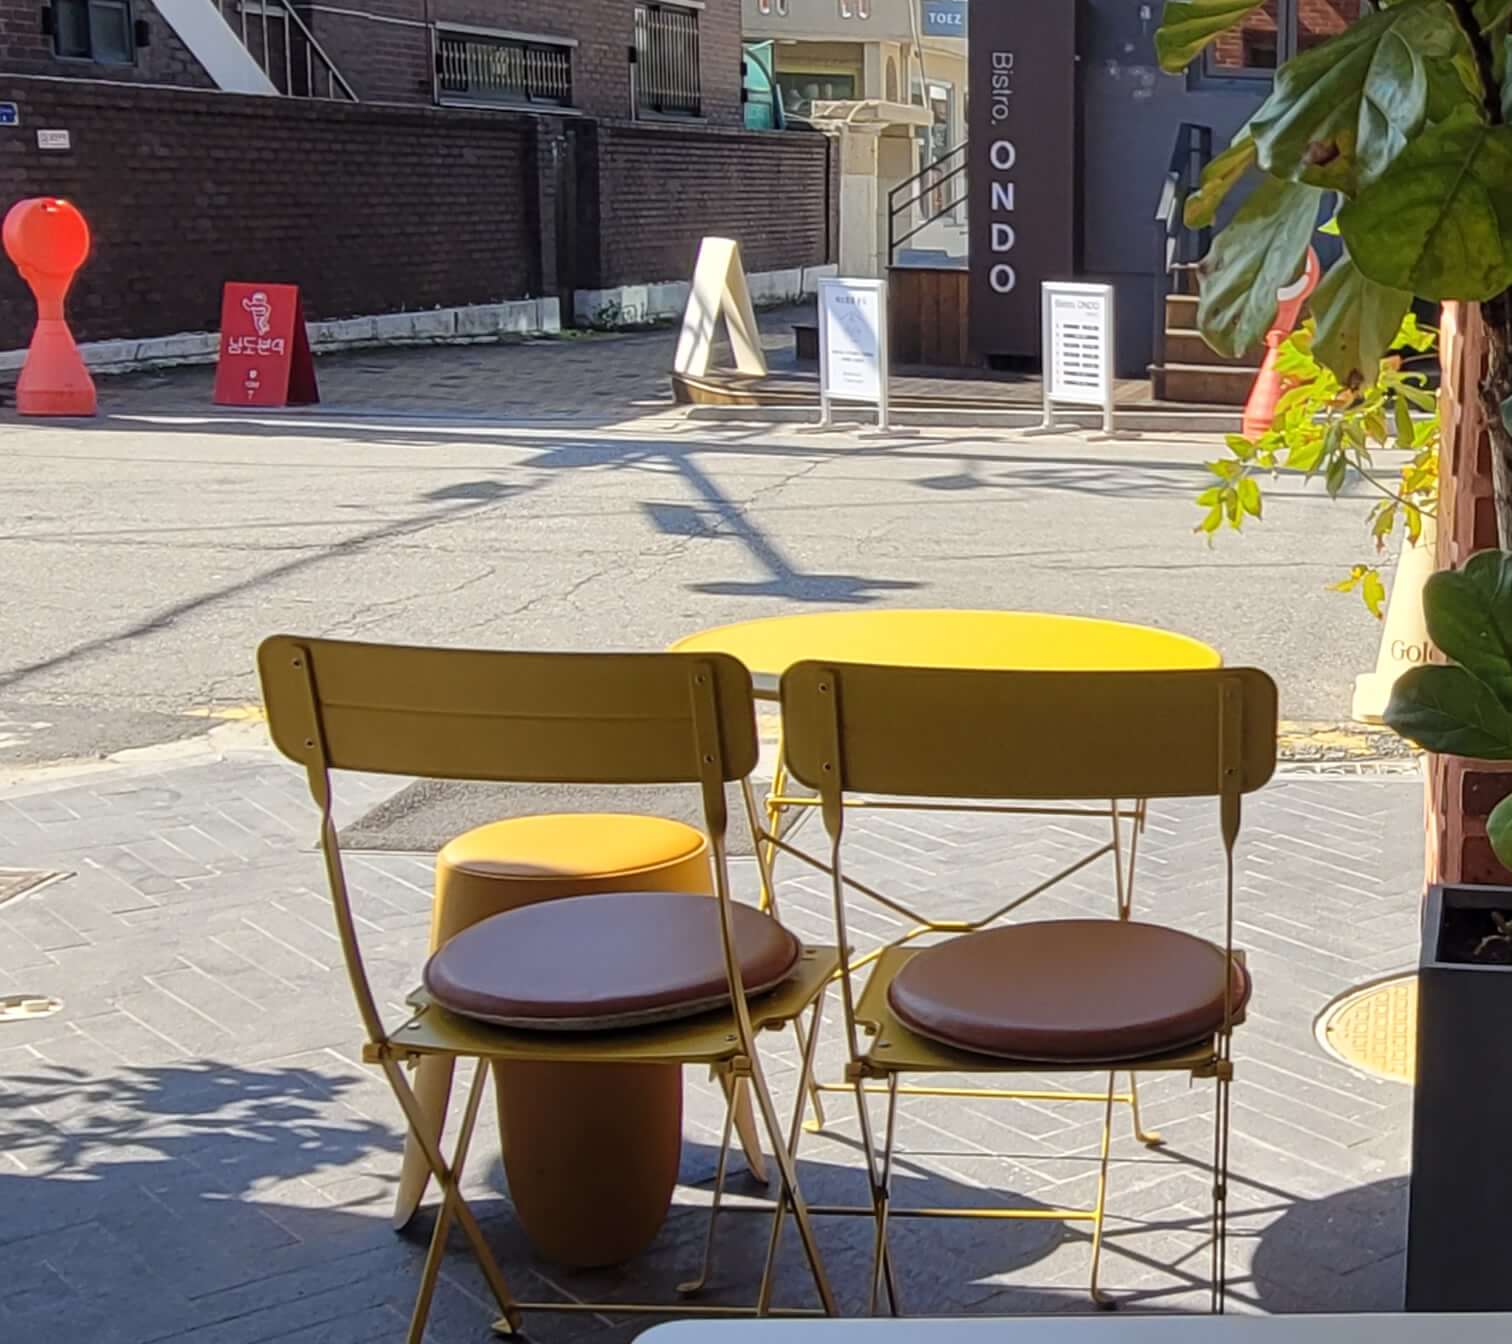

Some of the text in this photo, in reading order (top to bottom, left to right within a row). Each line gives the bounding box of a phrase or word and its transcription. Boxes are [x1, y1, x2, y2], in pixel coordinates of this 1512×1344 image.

[928, 12, 962, 25] TOEZ
[989, 51, 1016, 293] Bistro. ONDO
